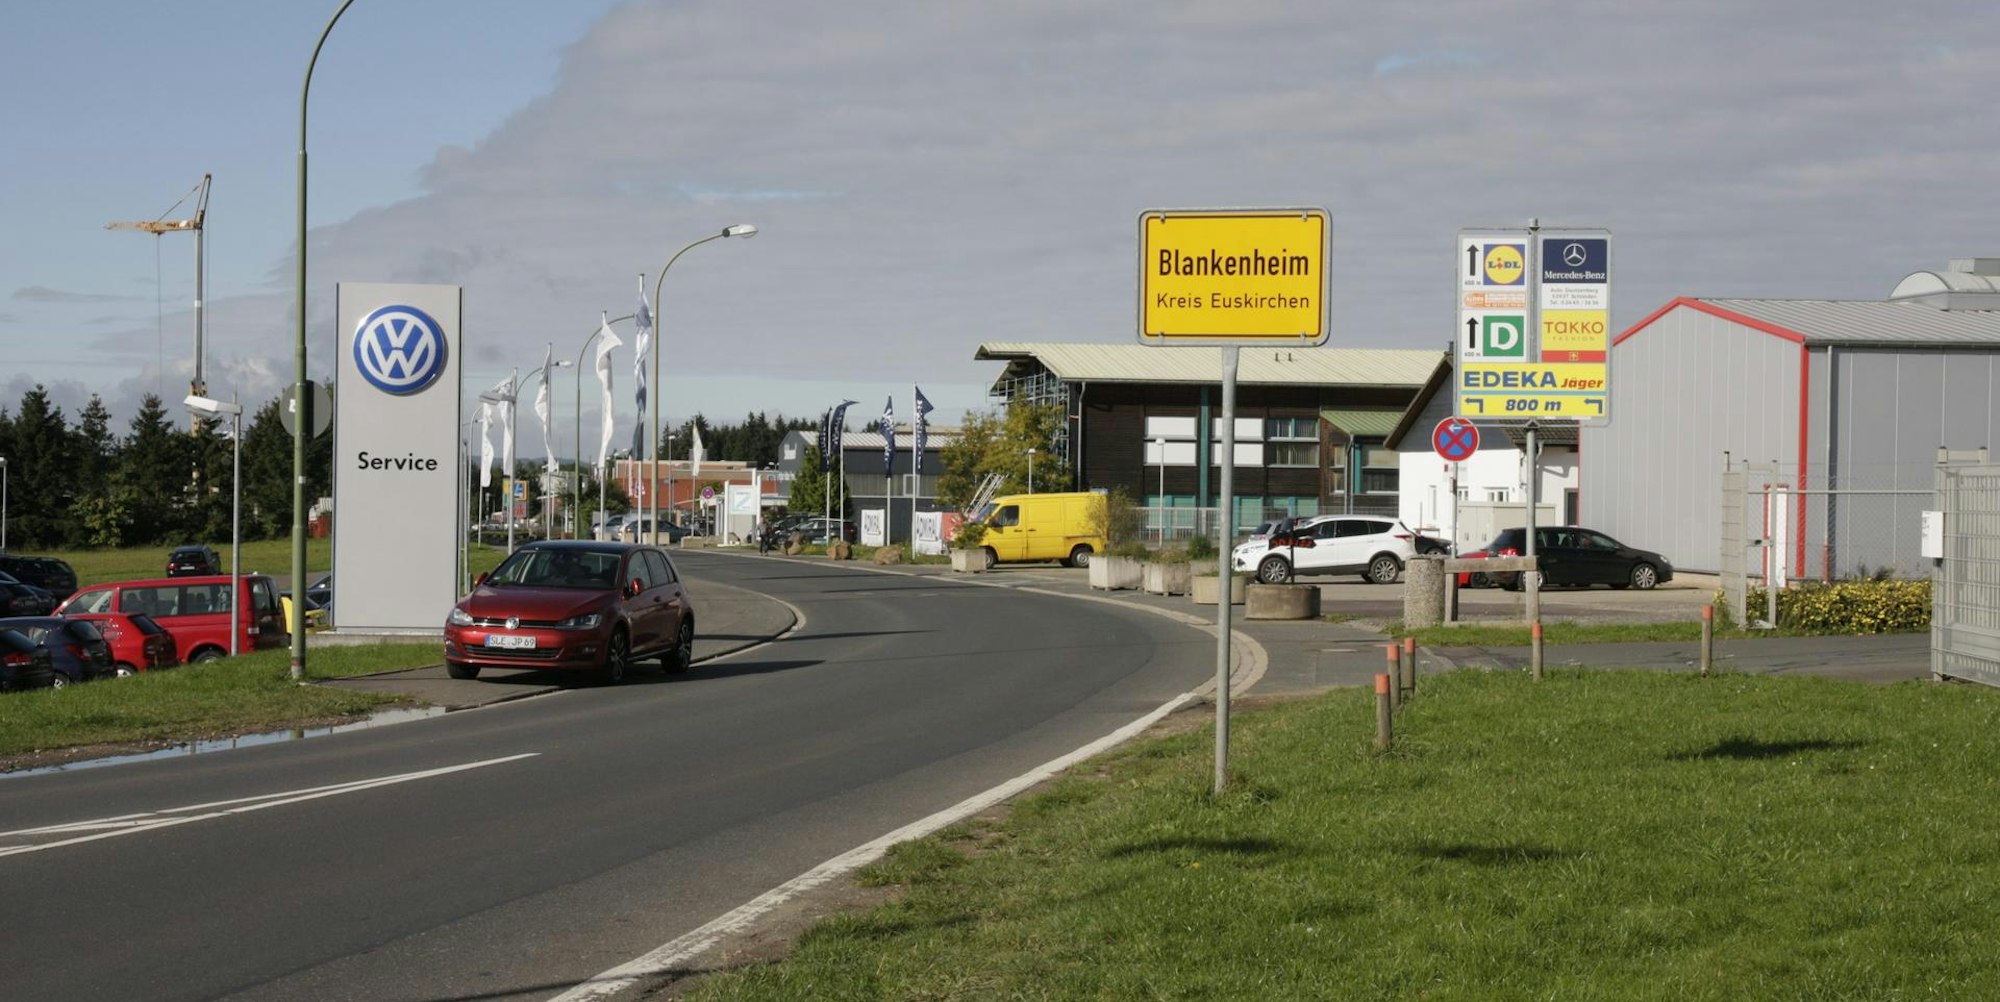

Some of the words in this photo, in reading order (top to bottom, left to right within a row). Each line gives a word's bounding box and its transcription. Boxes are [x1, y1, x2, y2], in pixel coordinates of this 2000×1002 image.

[1159, 248, 1309, 276] Blankenheim
[1544, 271, 1606, 281] Mercedes-Benz
[1157, 292, 1202, 309] Kreis
[1211, 292, 1309, 309] Euskirchen
[1490, 322, 1519, 350] D
[1463, 371, 1558, 388] EDEKA
[1560, 378, 1603, 390] Jäger
[1505, 399, 1539, 411] 800
[1544, 400, 1562, 411] m
[358, 451, 438, 471] Service
[490, 635, 506, 646] SLE
[511, 636, 523, 646] JP
[524, 637, 535, 647] 69
